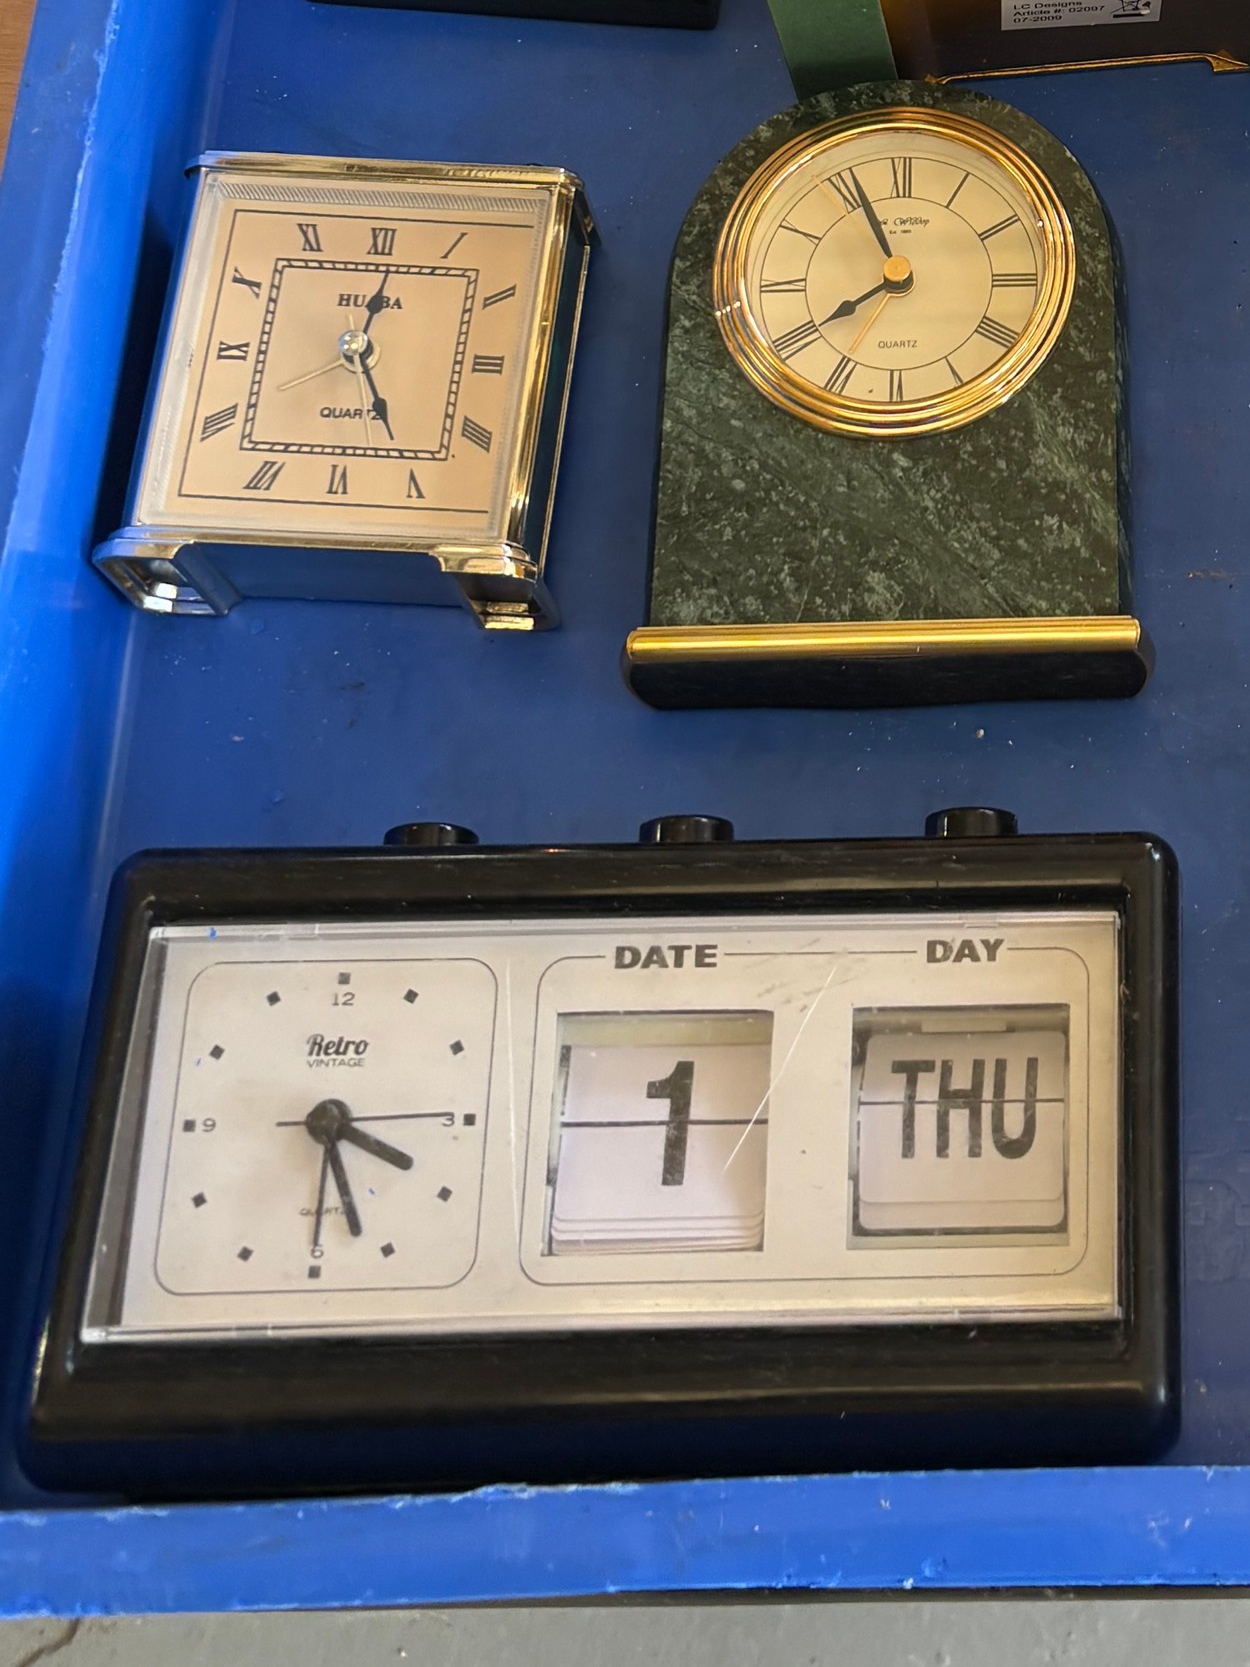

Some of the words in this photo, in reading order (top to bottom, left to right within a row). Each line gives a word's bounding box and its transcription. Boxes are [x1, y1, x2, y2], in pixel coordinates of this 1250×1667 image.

[1013, 3, 1031, 11] LC
[1034, 0, 1083, 9] Designs
[1013, 9, 1051, 17] Article
[890, 157, 912, 198] XII
[979, 214, 1019, 241] II
[367, 227, 397, 256] XII
[992, 273, 1038, 287] III
[337, 293, 403, 309] HUBA
[483, 284, 517, 310] II
[877, 339, 919, 350] QUARTZ
[471, 354, 505, 375] III
[614, 944, 718, 969] DATE
[925, 938, 1005, 963] DAY
[331, 992, 356, 1007] 12
[306, 1033, 370, 1058] Retro
[306, 1057, 366, 1069] VINTAGE
[890, 1056, 1039, 1160] THU
[202, 1118, 217, 1133] 9
[441, 1112, 456, 1127] 3
[645, 1060, 695, 1186] 1
[310, 1245, 324, 1259] 6
